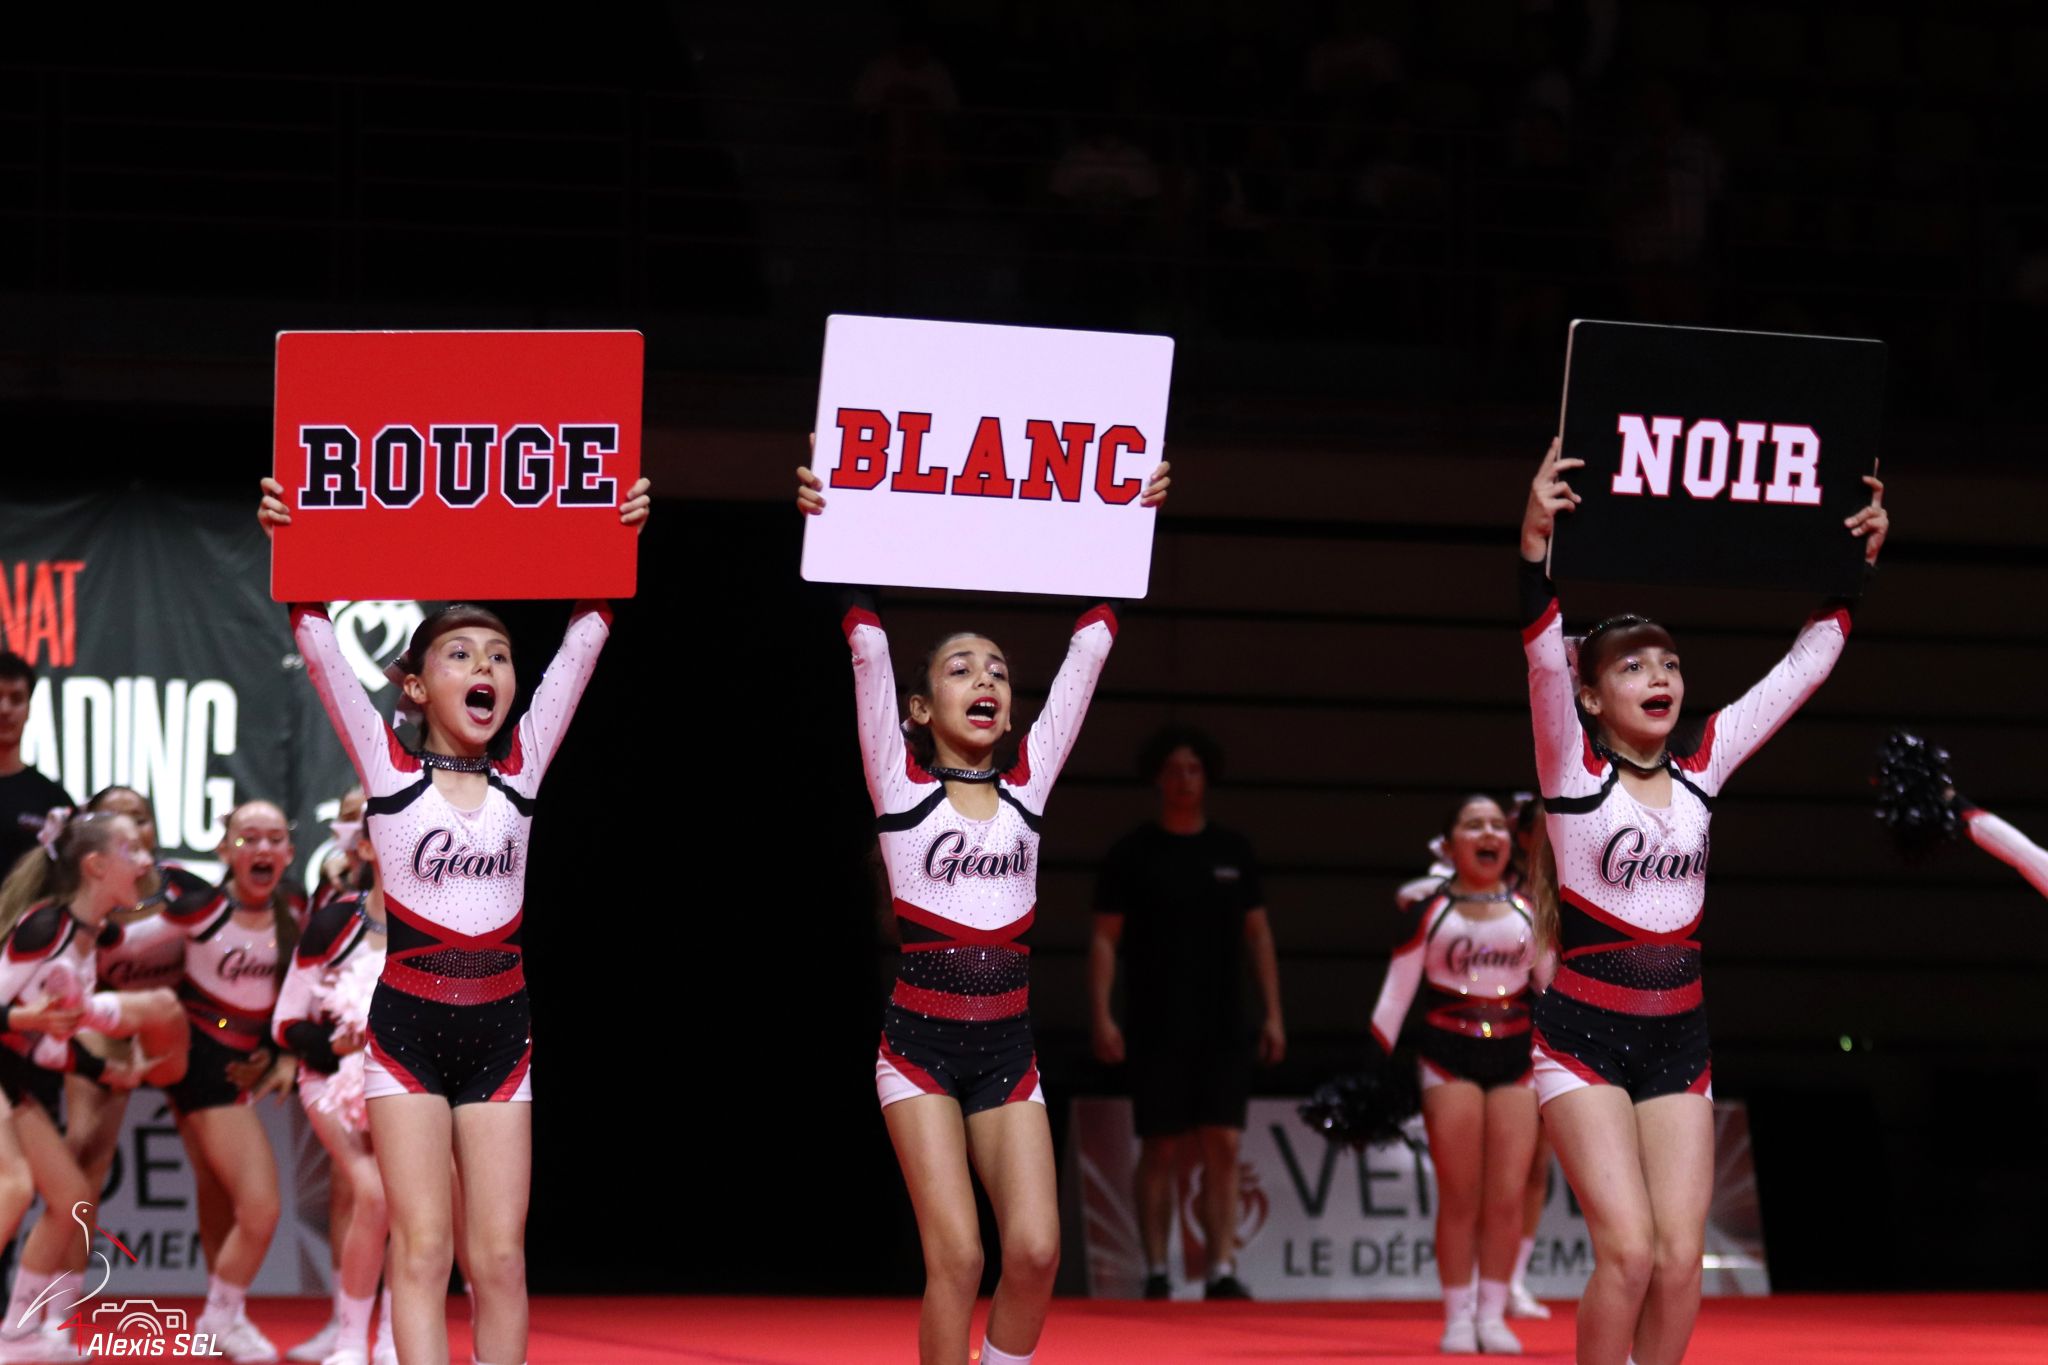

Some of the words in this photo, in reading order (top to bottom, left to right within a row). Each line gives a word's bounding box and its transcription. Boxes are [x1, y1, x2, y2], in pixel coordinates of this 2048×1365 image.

[298, 424, 619, 510] ROUGE
[830, 408, 1147, 506] BLANC
[1610, 412, 1824, 507] NOIR
[413, 827, 518, 885] Géant
[924, 830, 1020, 886] Géant
[1282, 1239, 1333, 1277] LE
